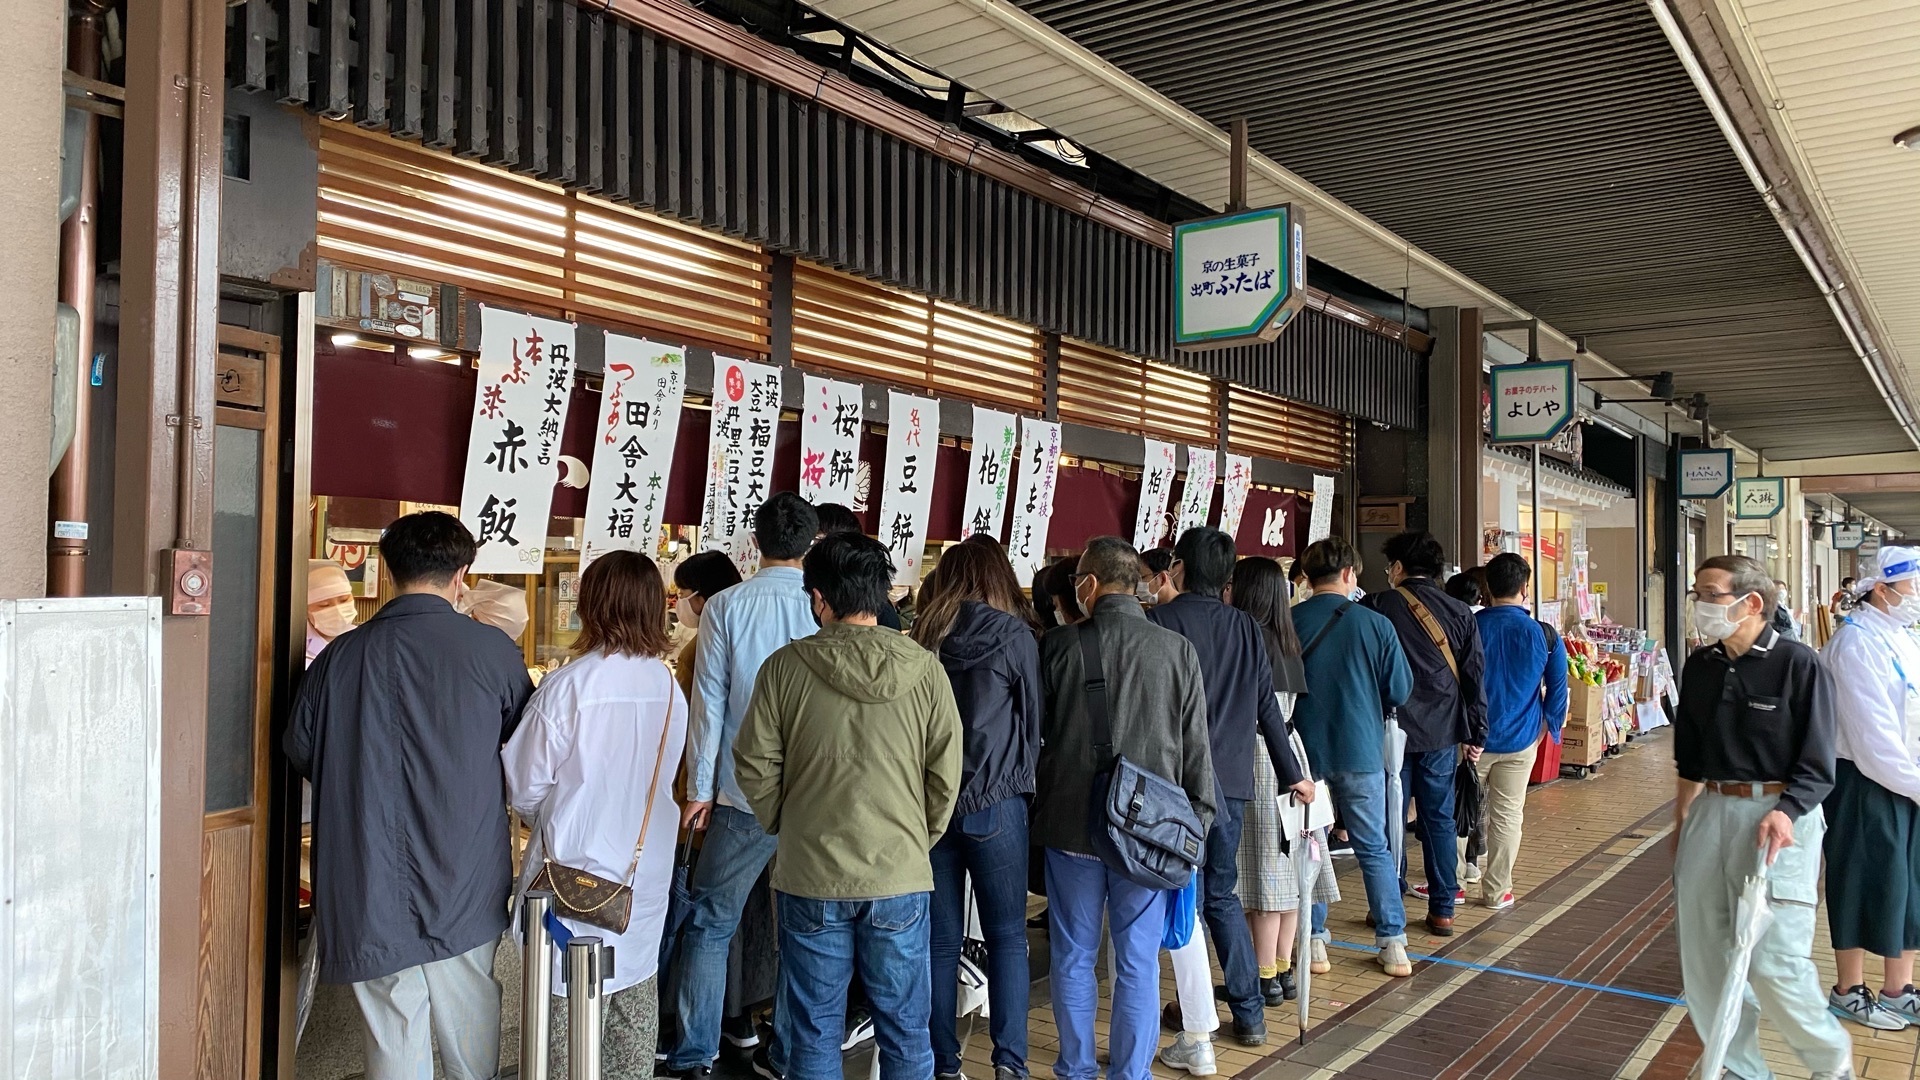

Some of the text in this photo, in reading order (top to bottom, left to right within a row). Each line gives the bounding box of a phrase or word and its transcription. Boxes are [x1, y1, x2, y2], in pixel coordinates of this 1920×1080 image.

[1190, 269, 1275, 297] 出町ふたば
[1202, 252, 1261, 274] 京の生菓子
[537, 343, 569, 466] 丹波大納言
[906, 407, 921, 449] 名代
[1504, 384, 1558, 396] お菓子のデパート
[1507, 400, 1560, 418] よしや
[477, 418, 529, 547] 赤飯
[606, 400, 650, 540] 田舎大福
[801, 446, 826, 489] 桜
[829, 394, 860, 491] 桜餅
[972, 442, 1000, 535] 柏餅
[995, 425, 1015, 519] 新緑の香り
[1038, 426, 1058, 518] 京都伝承の技
[1685, 470, 1722, 478] HANA
[889, 454, 917, 559] 豆餅
[1020, 440, 1044, 558] ちまき
